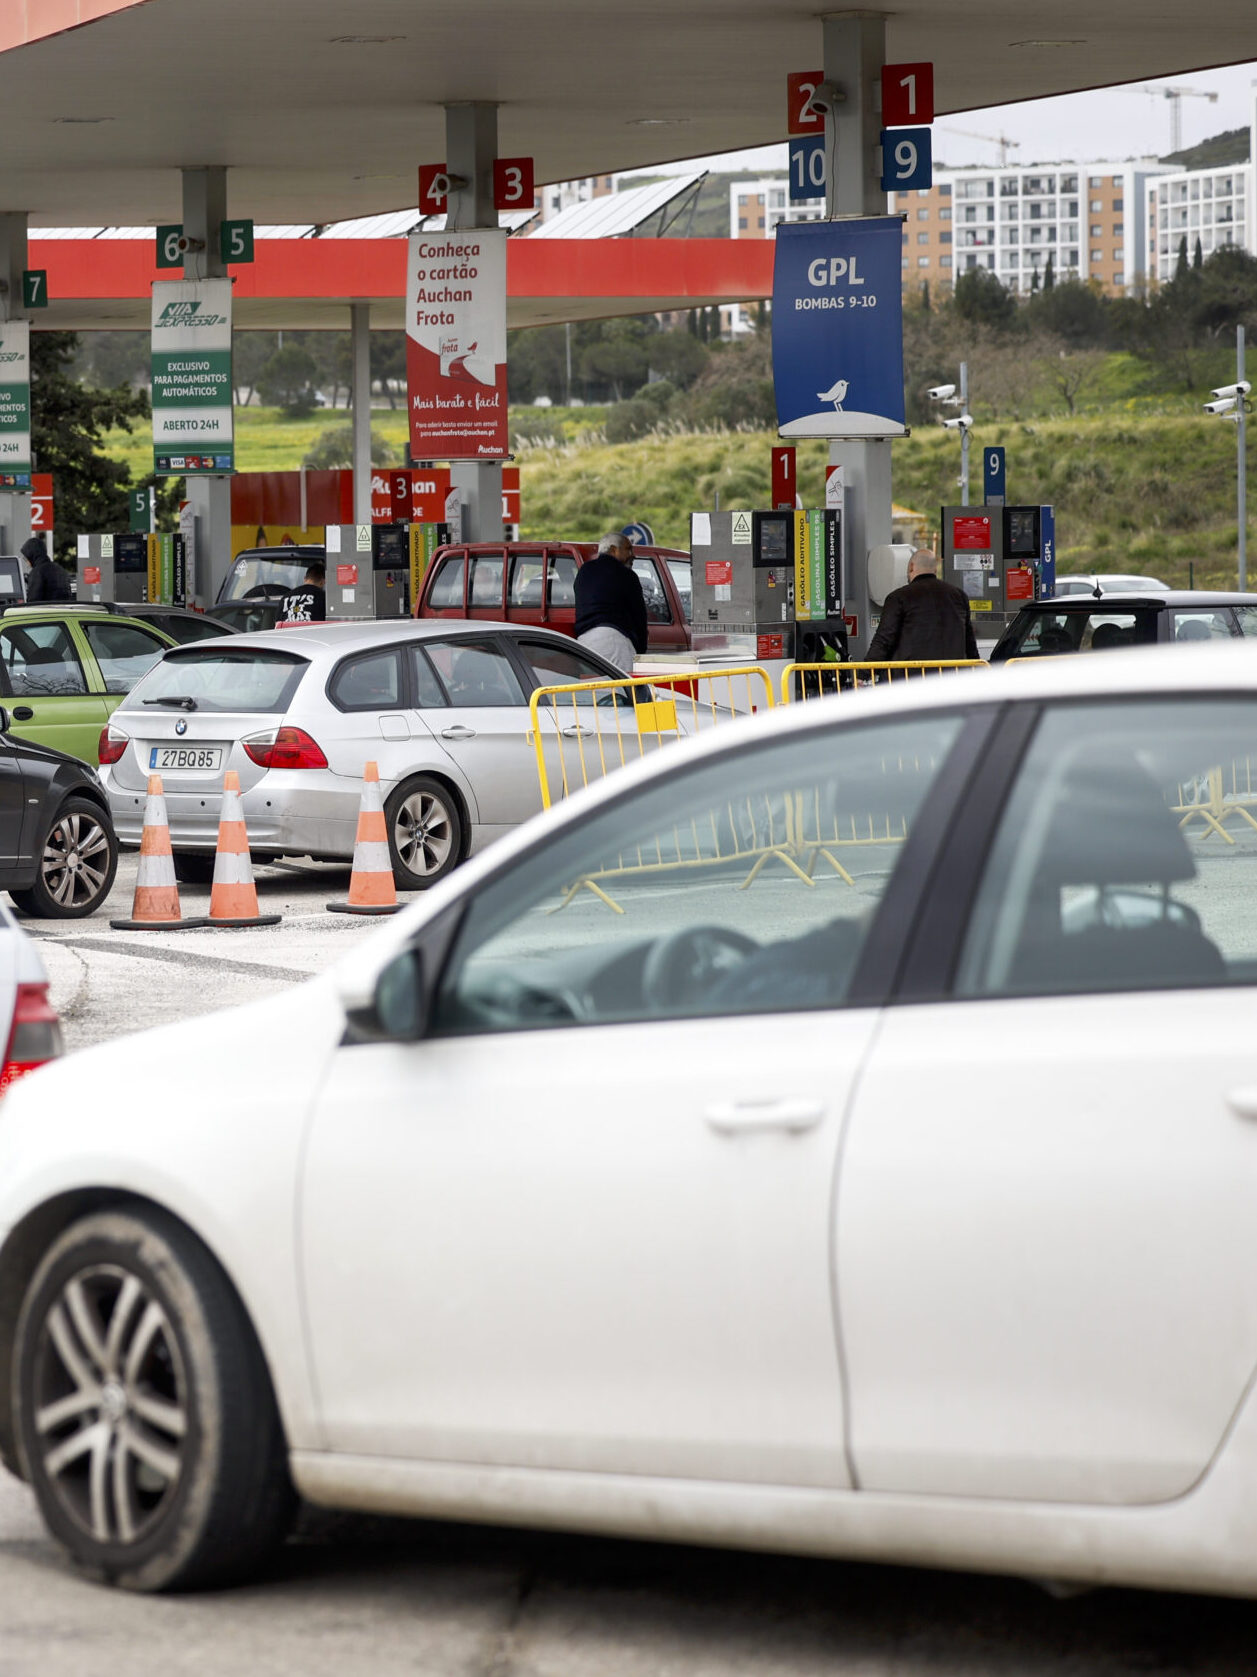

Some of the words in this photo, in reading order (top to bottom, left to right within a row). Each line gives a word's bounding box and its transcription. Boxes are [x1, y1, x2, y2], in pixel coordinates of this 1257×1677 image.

[798, 83, 817, 123] 2
[899, 74, 917, 116] 1
[791, 148, 826, 188] 10
[894, 140, 918, 180] 9
[426, 172, 442, 207] 4
[503, 166, 524, 201] 3
[164, 232, 179, 262] 6
[230, 227, 245, 256] 5
[418, 242, 481, 262] Conheça
[417, 269, 426, 281] o
[429, 263, 478, 280] cartão
[807, 256, 865, 287] GPL
[29, 276, 41, 302] 7
[416, 286, 473, 304] Auchan
[795, 296, 845, 311] BOMBAS
[849, 295, 877, 309] 9-10
[416, 310, 455, 327] Frota
[167, 361, 210, 372] EXCLUSIVO
[154, 375, 173, 385] PARA
[173, 373, 227, 384] PAGAMENTOS
[162, 385, 217, 397] AUTOMÁTICOS
[413, 394, 434, 410] Mais
[435, 393, 465, 409] barato
[467, 400, 473, 408] e
[163, 420, 198, 431] ABERTO
[200, 419, 219, 430] 24H
[3, 443, 19, 452] 24H
[477, 444, 504, 454] Auchan
[779, 453, 790, 480] 1
[989, 453, 1000, 476] 9
[396, 477, 407, 499] 3
[135, 493, 145, 512] 5
[501, 496, 511, 518] 1
[30, 503, 44, 525] 2
[1044, 539, 1052, 563] GPL
[283, 594, 314, 612] IT'S
